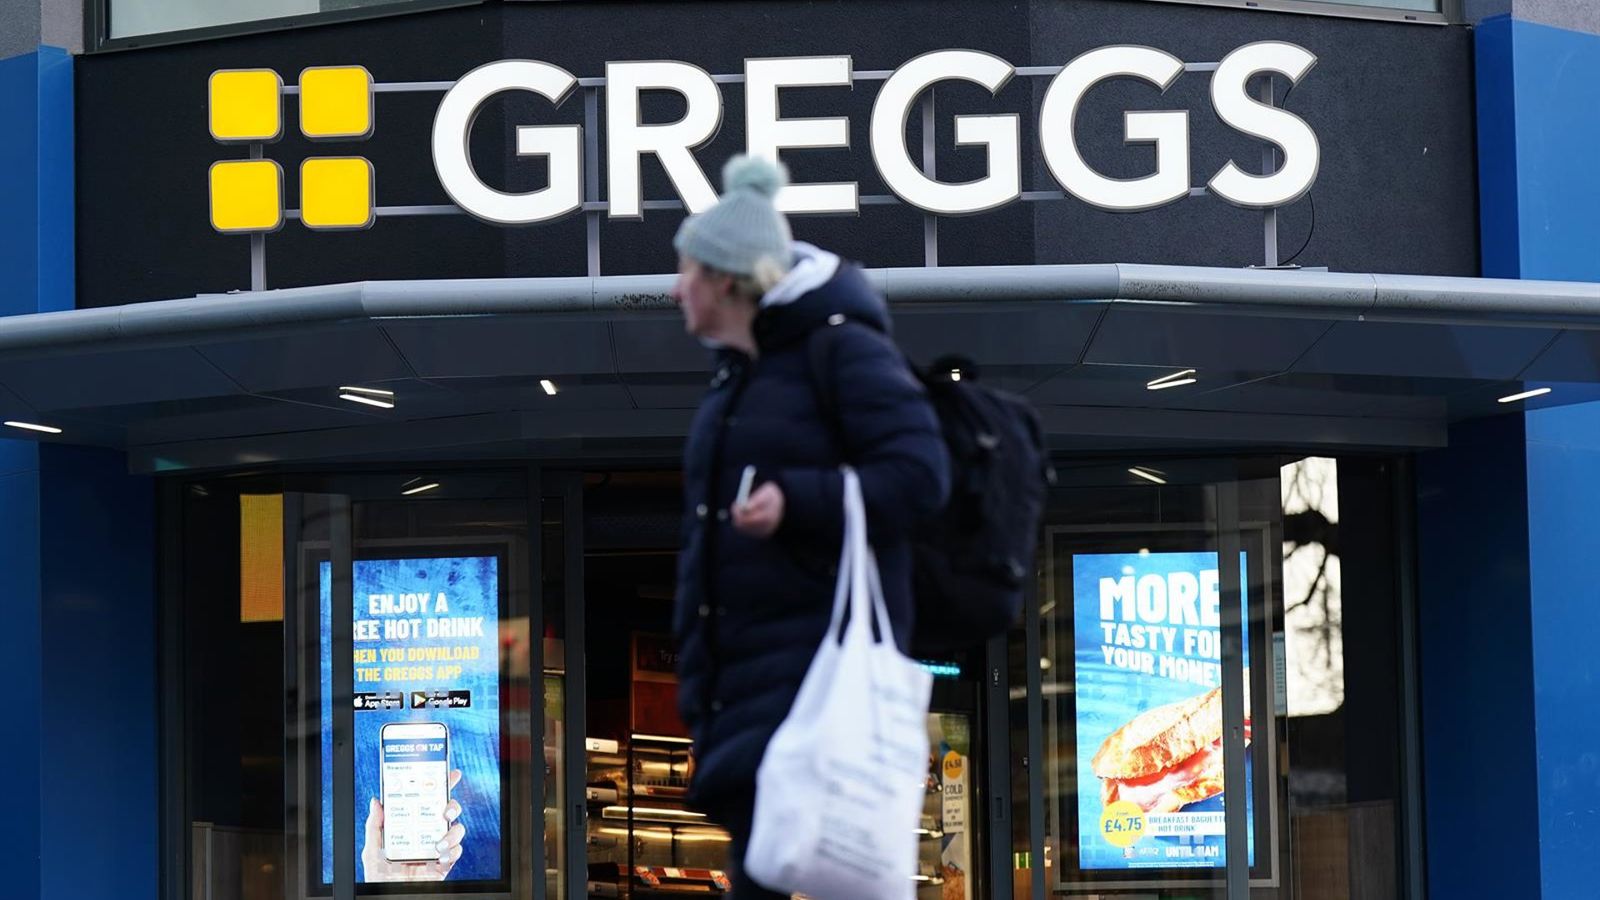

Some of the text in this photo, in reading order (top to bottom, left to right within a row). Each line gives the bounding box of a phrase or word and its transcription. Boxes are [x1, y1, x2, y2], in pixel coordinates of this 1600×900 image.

[431, 40, 1321, 225] GREGGS
[369, 592, 448, 614] ENJOY A
[1099, 569, 1221, 627] MORE
[384, 618, 422, 639] HOT
[427, 617, 484, 637] DRINK
[1100, 622, 1178, 653] TASTY
[353, 646, 480, 664] HEN YOU DOWNLOAD
[1101, 645, 1155, 675] YOUR
[356, 665, 462, 682] THE GREGGS APP
[365, 700, 380, 709] App
[453, 696, 468, 707] Play
[386, 744, 415, 752] GREGGS
[429, 743, 444, 752] TAP
[944, 783, 963, 795] COLD
[1105, 817, 1142, 832] £4.75
[1149, 815, 1226, 824] BREAKFAST BAGUETT
[1165, 846, 1193, 858] UNTIL
